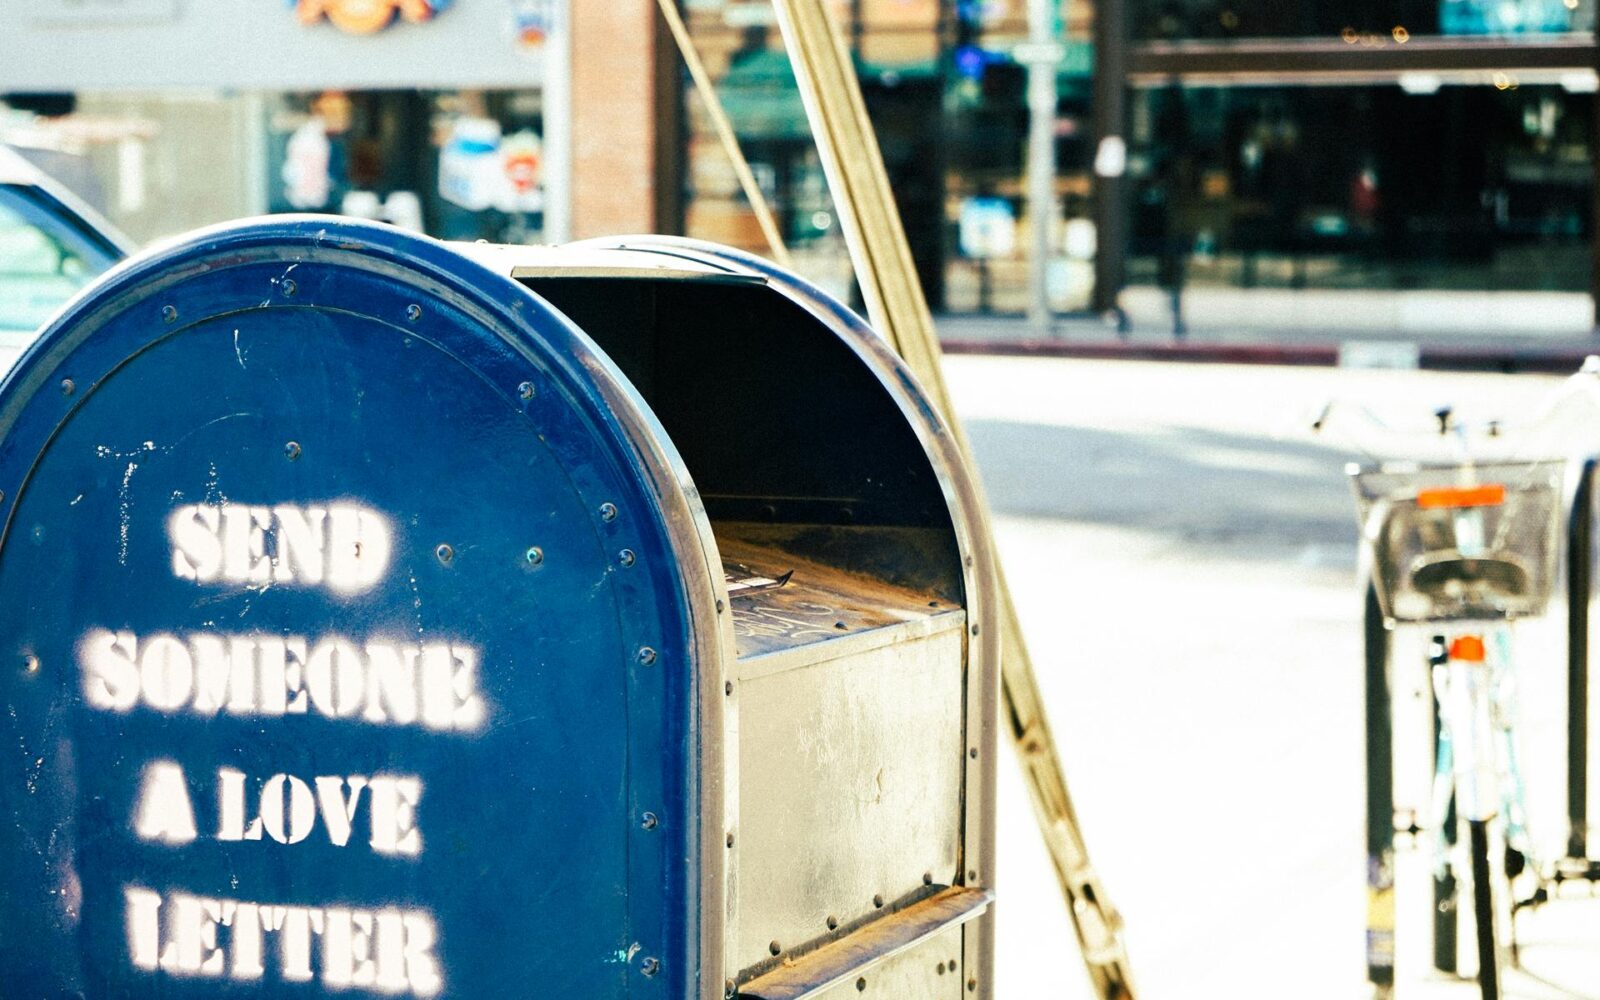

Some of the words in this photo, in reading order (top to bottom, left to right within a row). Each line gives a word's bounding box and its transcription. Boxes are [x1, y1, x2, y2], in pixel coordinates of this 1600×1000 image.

[169, 501, 393, 593] SEND
[80, 630, 485, 731] SOMEONE
[136, 760, 198, 843] A
[217, 768, 422, 857] LOVE
[126, 887, 443, 997] LETTER
